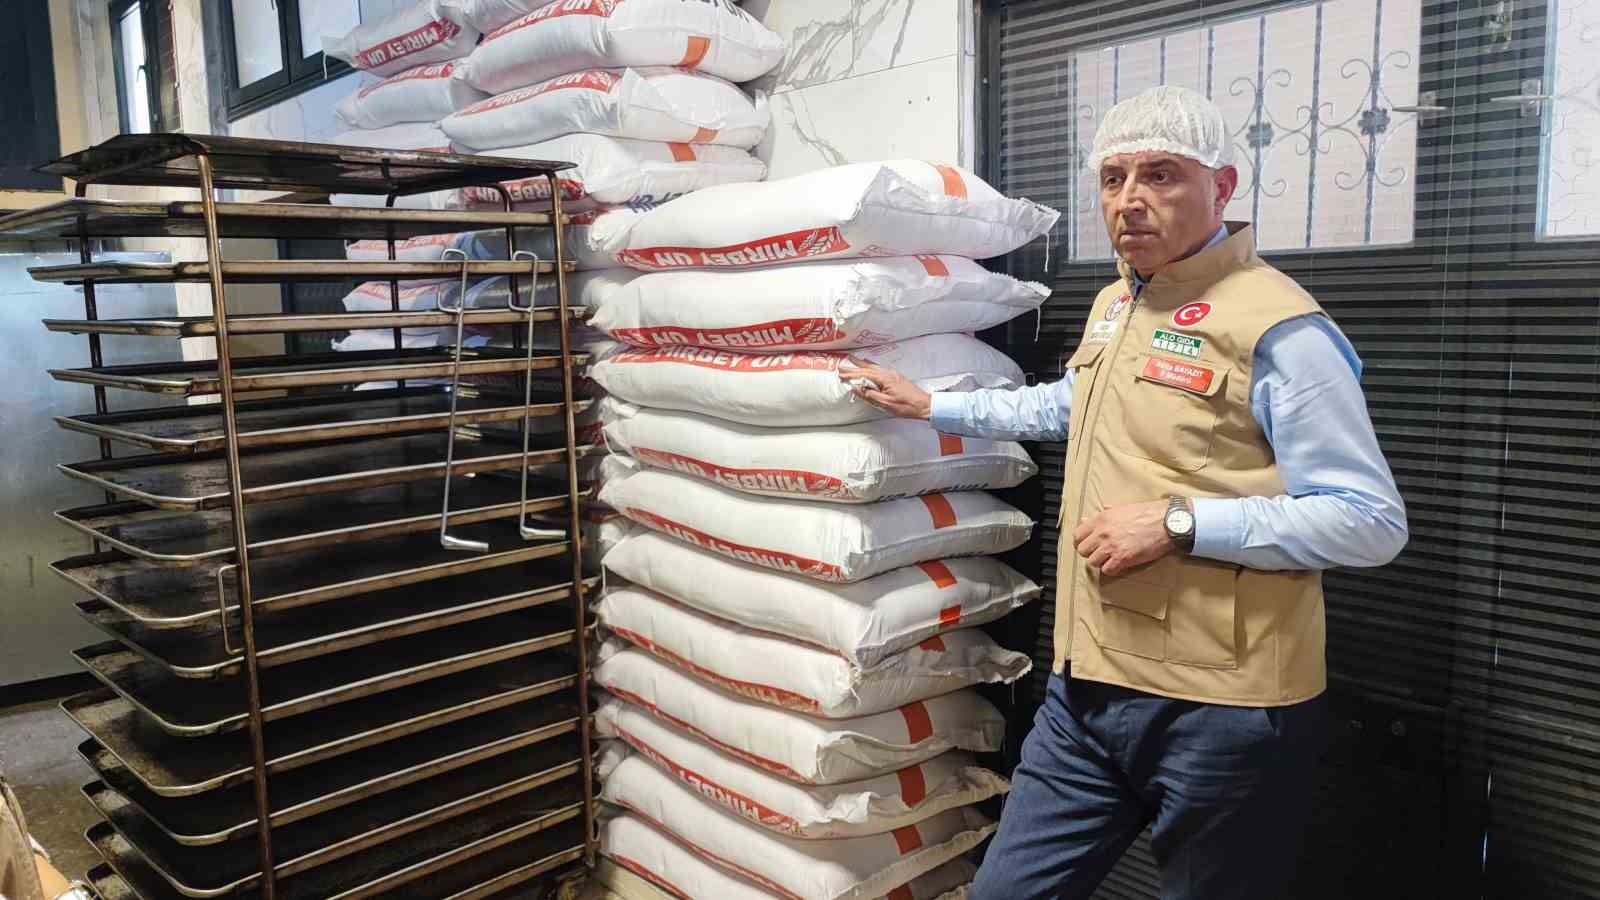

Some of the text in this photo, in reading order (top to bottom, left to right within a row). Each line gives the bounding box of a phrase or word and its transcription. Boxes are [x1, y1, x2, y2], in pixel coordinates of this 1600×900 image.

[368, 48, 386, 66] UN
[653, 251, 694, 267] UN
[650, 331, 689, 346] UN
[751, 354, 794, 368] UN
